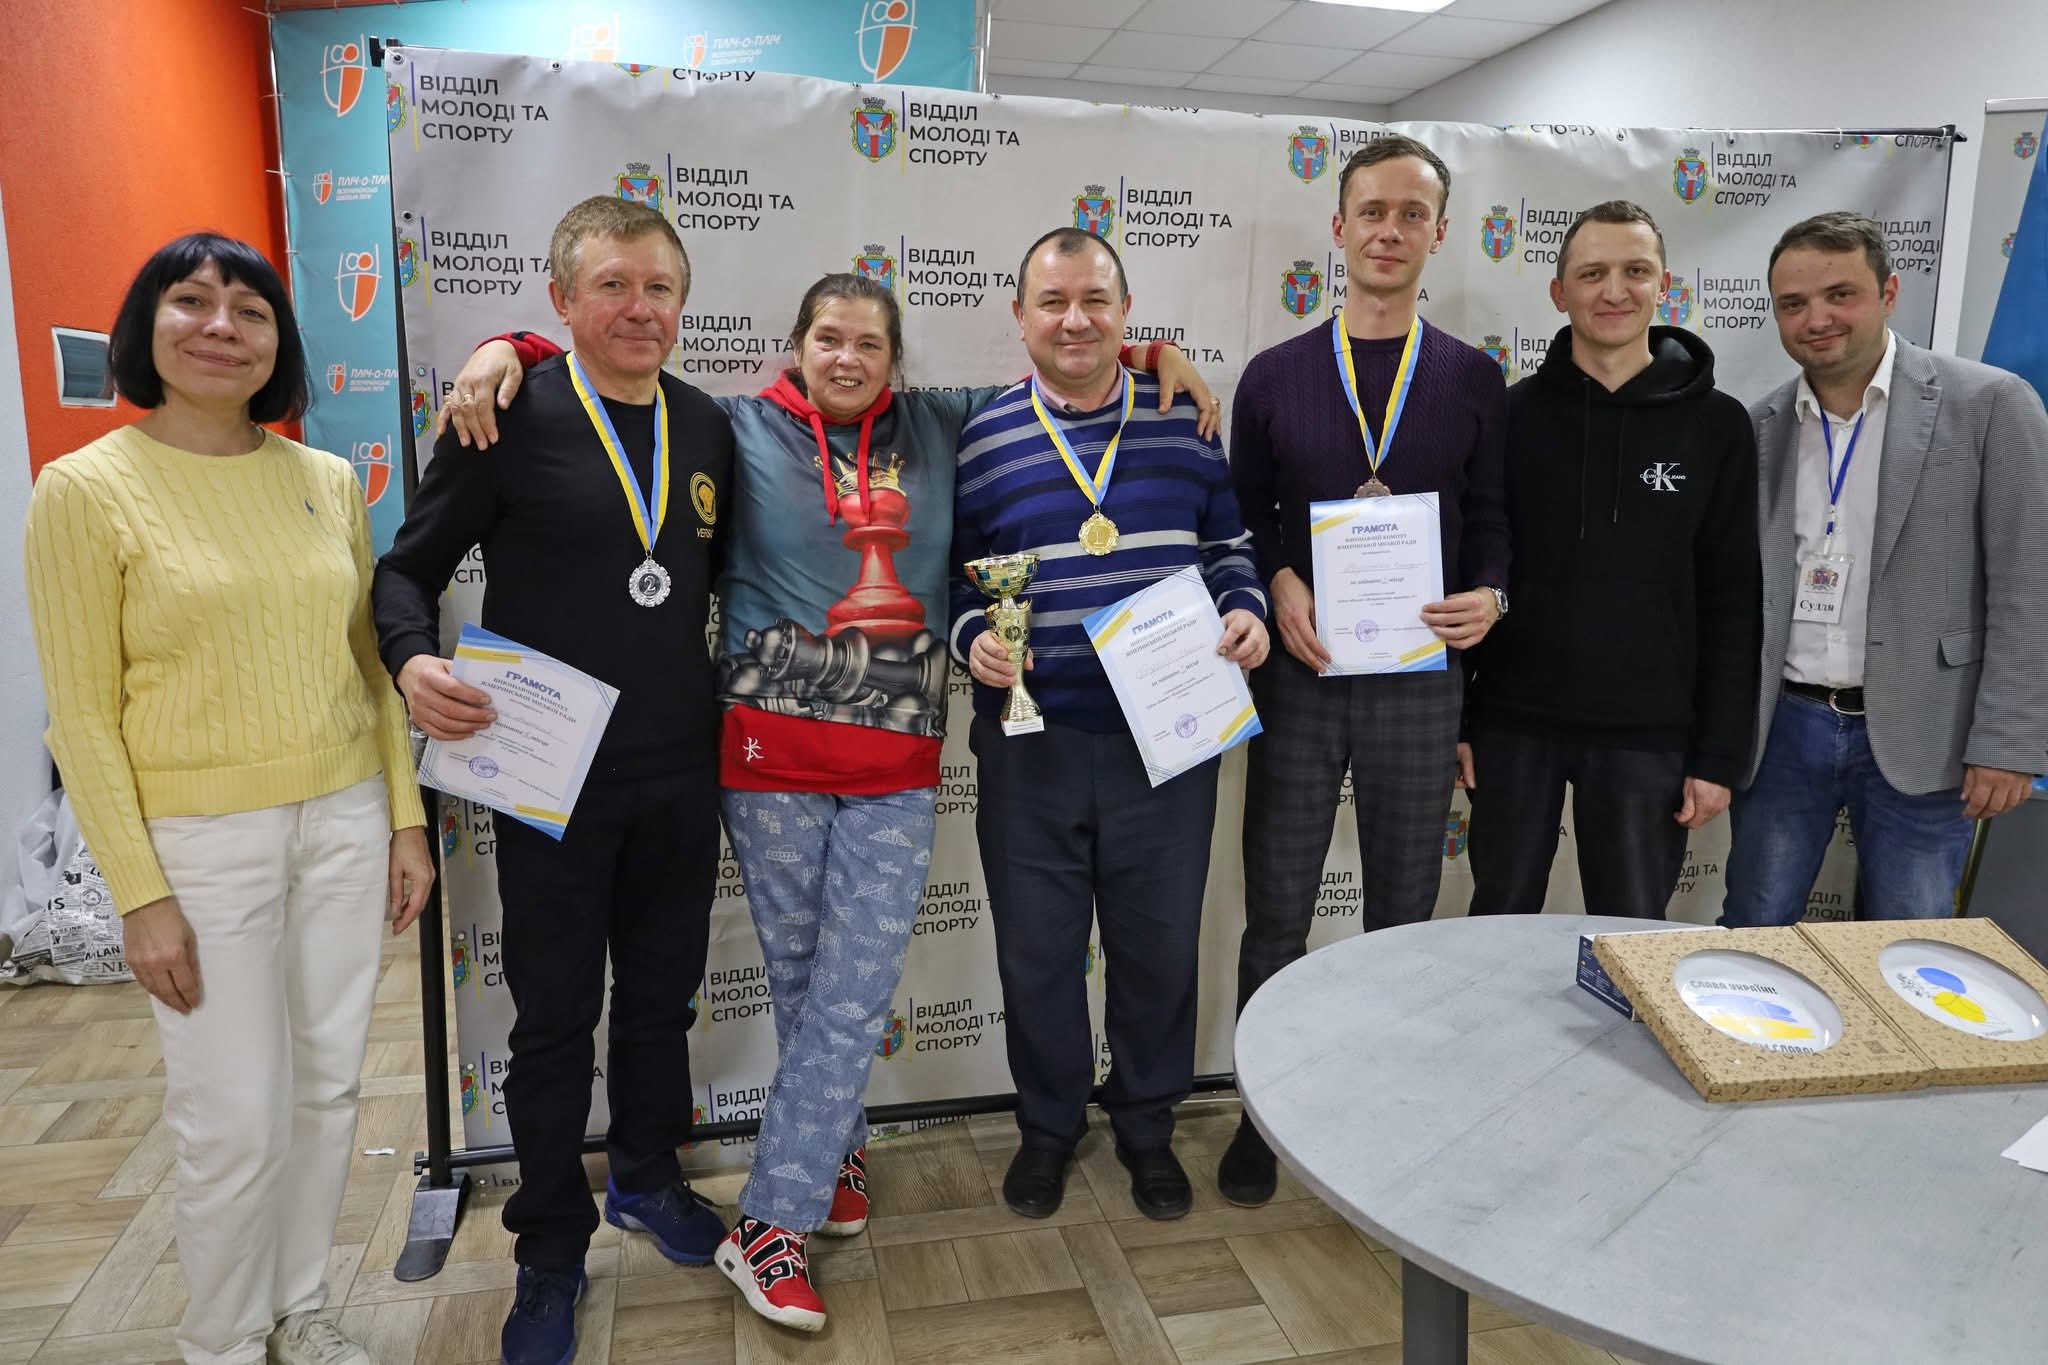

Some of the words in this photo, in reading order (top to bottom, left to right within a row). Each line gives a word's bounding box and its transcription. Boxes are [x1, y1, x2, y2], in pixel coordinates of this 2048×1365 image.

[420, 75, 498, 96] ВІДДІЛ
[421, 99, 515, 122] МОЛОДІ
[521, 105, 549, 121] ТА
[910, 103, 978, 122] ВІДДІЛ
[422, 123, 513, 143] СПОРТУ
[910, 125, 990, 147] МОЛОДІ
[995, 130, 1020, 146] ТА
[909, 148, 987, 166] СПОРТУ
[1717, 153, 1772, 168] ВІДДІЛ
[676, 167, 748, 187] ВІДДІЛ
[1717, 172, 1776, 187] МОЛОДІ
[1780, 175, 1797, 188] ТА
[677, 190, 763, 211] МОЛОДІ
[769, 194, 795, 210] ТА
[1127, 189, 1192, 207] ВІДДІЛ
[1714, 191, 1770, 206] СПОРТУ
[677, 213, 760, 231] СПОРТУ
[1126, 210, 1203, 230] МОЛОДІ
[1209, 213, 1233, 228] ТА
[431, 231, 508, 251] ВІДДІЛ
[1125, 231, 1200, 248] СПОРТУ
[1887, 239, 1940, 254] ОЛОДІ
[432, 254, 524, 275] МОЛОДІ
[908, 248, 975, 266] ВІДДІЛ
[1524, 249, 1559, 264] СПО
[434, 278, 522, 295] СПОРТУ
[908, 270, 987, 289] МОЛОДІ
[993, 273, 1016, 288] ТА
[1704, 278, 1760, 294] ВІДДІЛ
[908, 291, 984, 308] СПОРТУ
[1704, 297, 1770, 312] МОЛОДІ
[682, 315, 751, 333] ВІДДІЛ
[1704, 315, 1766, 330] СПОРТУ
[683, 337, 766, 355] МОЛОДІ
[1202, 349, 1224, 363] ТА
[683, 358, 764, 374] СПОРТУ
[1351, 523, 1399, 534] ГРАМОТА
[643, 575, 657, 594] 2
[1131, 608, 1176, 636] ГРАМОТА
[504, 669, 563, 700] ГРАМОТА
[941, 766, 970, 781] ДІЛ
[935, 801, 978, 815] ОРТУ
[1704, 864, 1718, 875] ТА
[924, 882, 970, 899] ІДДІЛ
[1809, 892, 1841, 905] ДІЛ
[1313, 905, 1358, 917] ОРТУ
[912, 917, 979, 936] СПОРТУ
[711, 985, 771, 1004] МОЛО
[711, 1001, 773, 1022] СПОРТ
[916, 999, 972, 1019] ВІДДІЛ
[916, 1014, 983, 1035] МОЛОДІ
[915, 1033, 982, 1052] СПОРТУ
[717, 1087, 772, 1107] ВІДДІ
